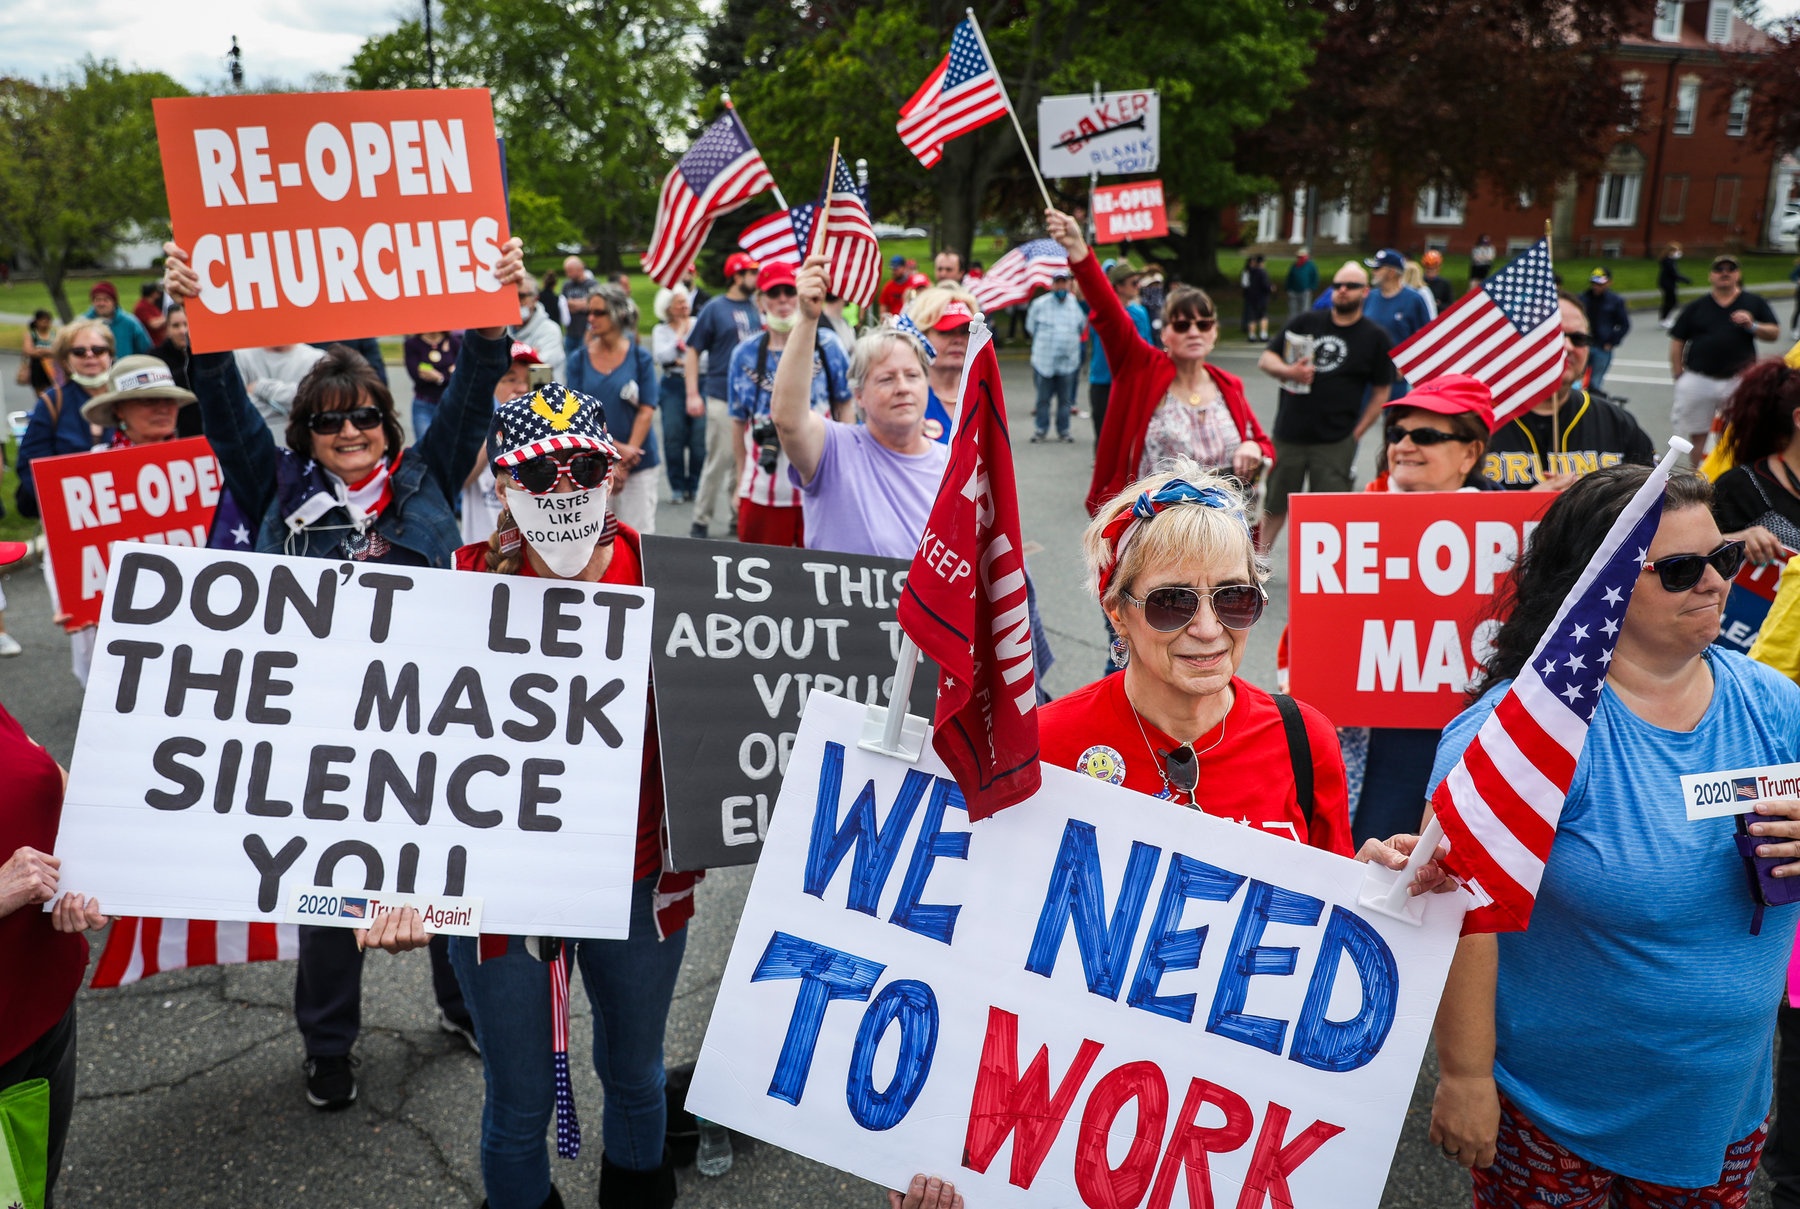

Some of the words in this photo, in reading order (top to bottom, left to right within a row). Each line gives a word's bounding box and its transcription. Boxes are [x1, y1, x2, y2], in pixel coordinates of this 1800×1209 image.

[1060, 92, 1149, 155] BAKER
[1090, 137, 1152, 163] BLANK
[194, 119, 472, 207] RE-OPEN
[1094, 186, 1163, 214] RE-OPEN
[1109, 211, 1153, 235] MASS
[191, 216, 502, 314] CHURCHES
[61, 456, 223, 531] RE-OPE
[1482, 450, 1624, 485] BRUINS
[534, 492, 590, 510] TASTES
[549, 512, 582, 525] LIKE
[526, 520, 599, 542] SOCIALISM
[918, 527, 971, 584] KEEP
[1300, 520, 1541, 596] RE-OP
[111, 551, 414, 643] DON'T
[488, 583, 644, 661] LET
[712, 556, 772, 602] IS
[666, 613, 849, 661] ABOUT
[1357, 619, 1505, 693] MAS
[108, 640, 297, 724] THE
[354, 660, 624, 748] MASK
[145, 737, 565, 832] SILENCE
[1694, 781, 1732, 806] 2020
[1758, 776, 1800, 798] Trump
[243, 834, 466, 912] YOU
[297, 894, 338, 916] 2020
[423, 904, 472, 928] Again!
[803, 741, 972, 945] WE
[1025, 818, 1400, 1073] NEED
[751, 931, 940, 1132] TO
[961, 1006, 1346, 1209] WORK
[1536, 1186, 1572, 1207] TEXAS
